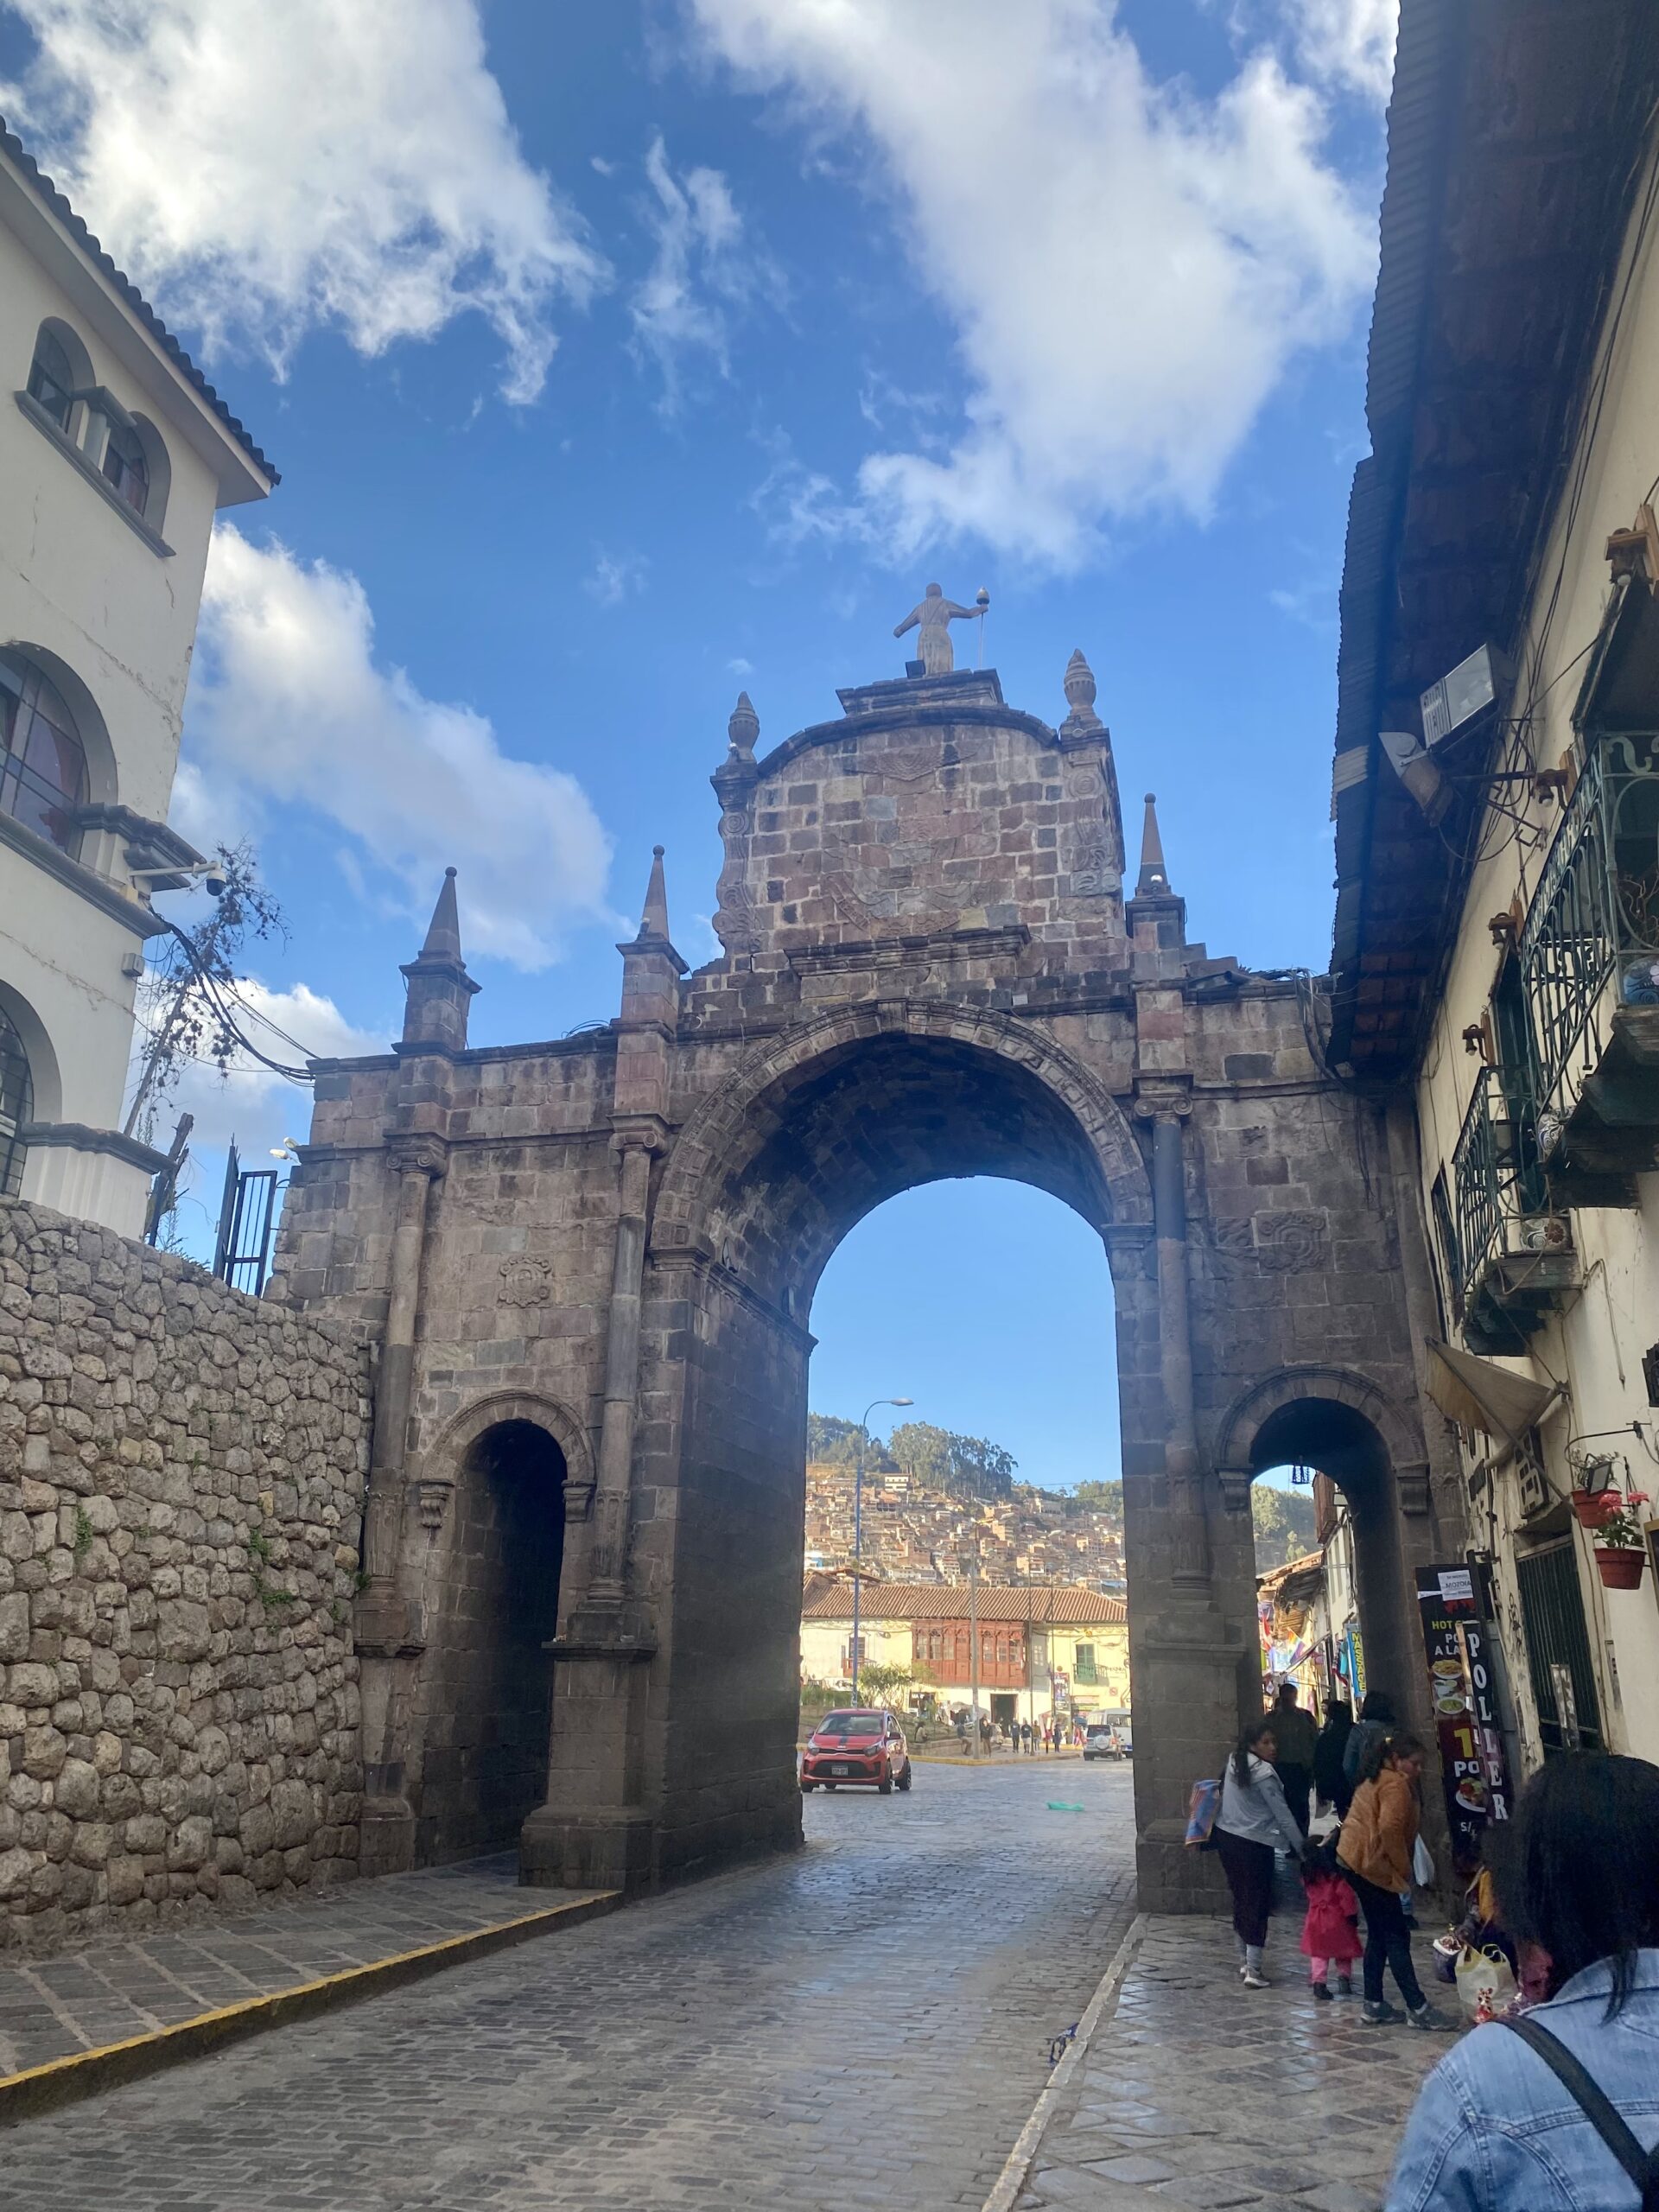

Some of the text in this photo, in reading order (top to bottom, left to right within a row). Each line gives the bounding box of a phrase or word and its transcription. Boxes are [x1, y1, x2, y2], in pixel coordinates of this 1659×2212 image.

[1432, 1620, 1452, 1630] HOT
[1434, 1645, 1461, 1656] A LA
[1351, 1632, 1366, 1693] MASSAGE
